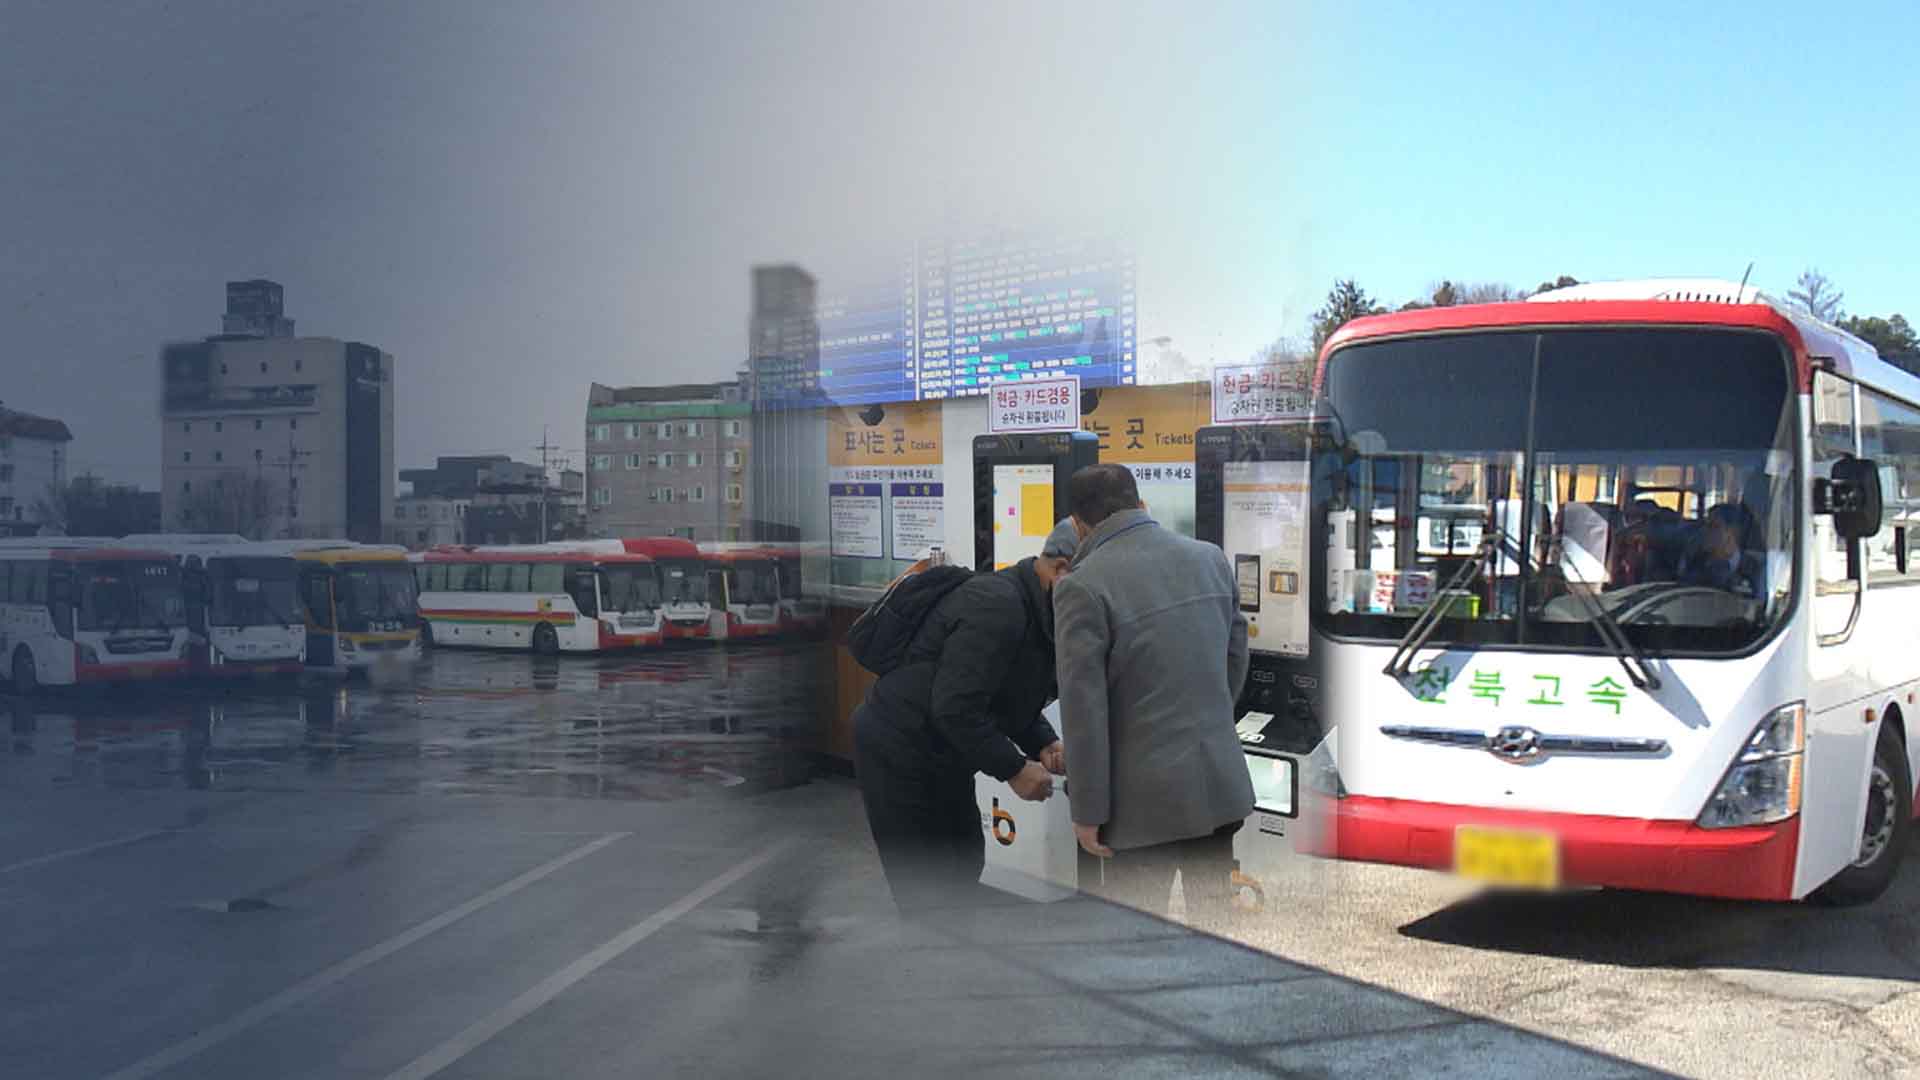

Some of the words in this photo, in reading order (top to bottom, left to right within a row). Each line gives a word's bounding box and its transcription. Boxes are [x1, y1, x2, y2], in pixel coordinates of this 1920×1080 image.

[1126, 418, 1144, 449] 곳
[1154, 432, 1193, 446] Tickets
[1165, 468, 1192, 480] 주세요
[1414, 666, 1628, 714] 전북고속
